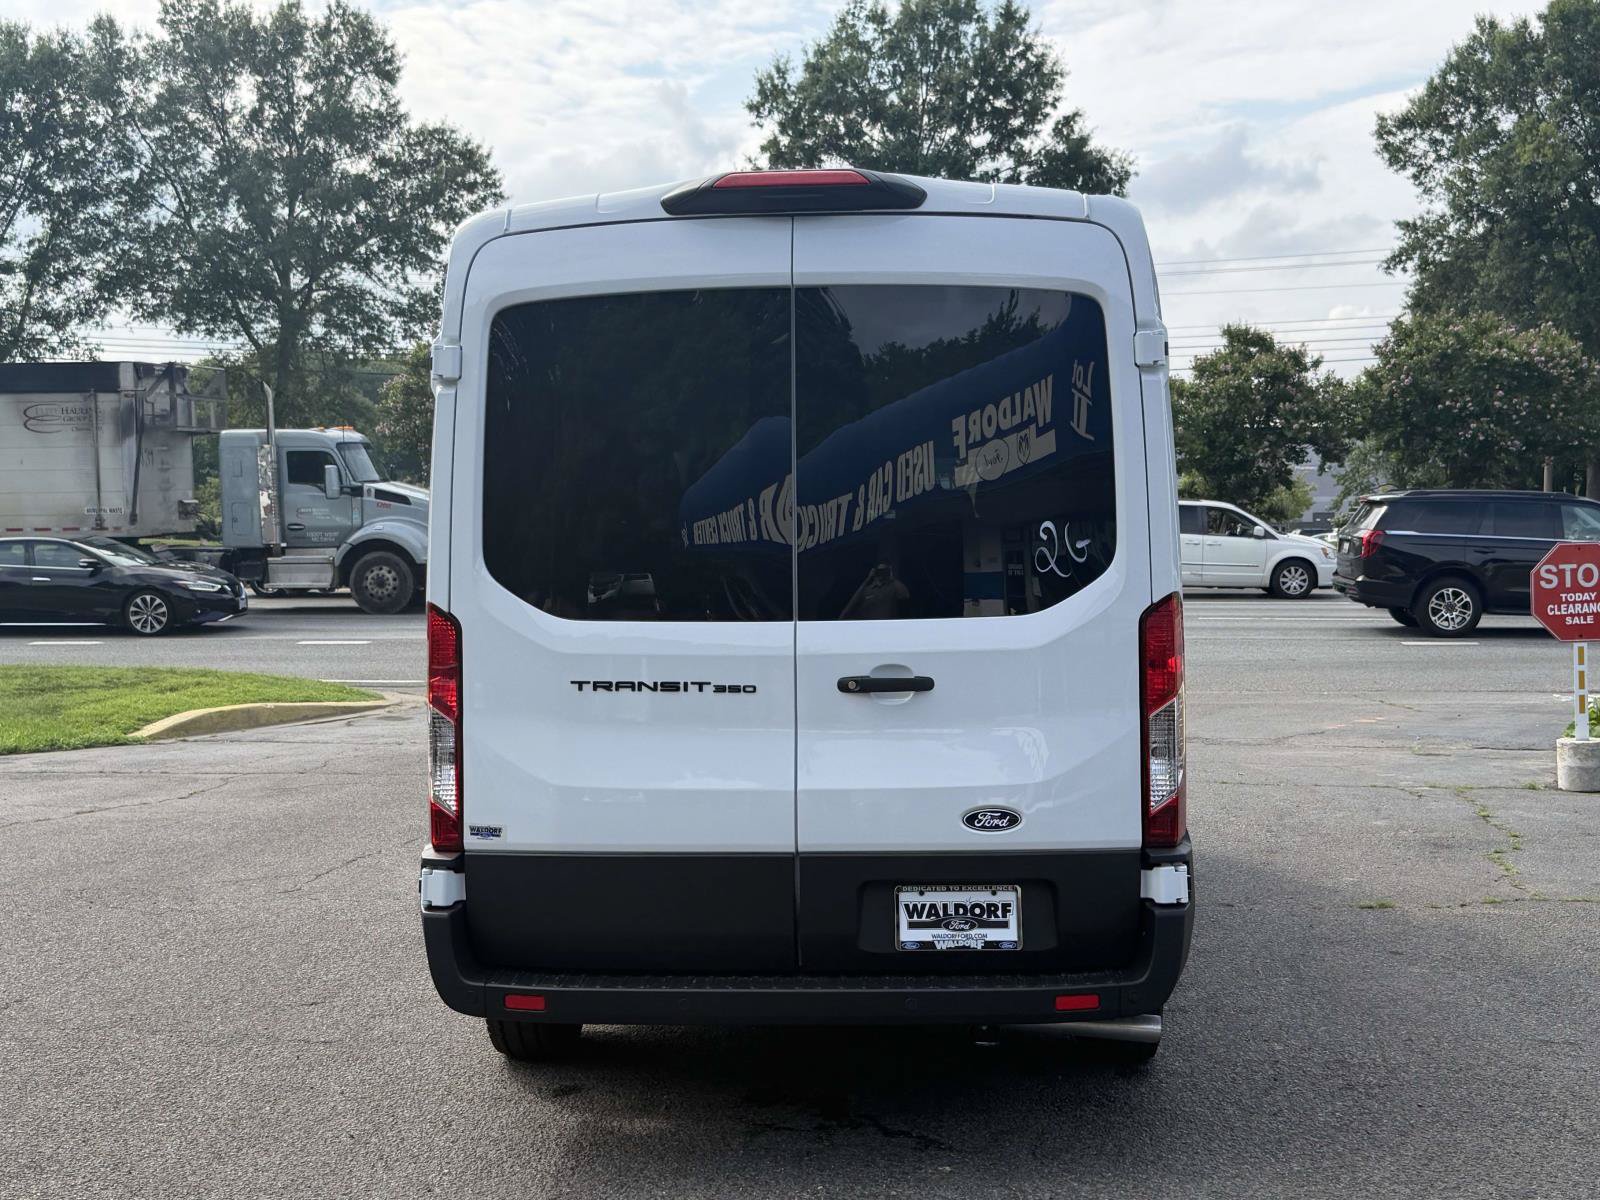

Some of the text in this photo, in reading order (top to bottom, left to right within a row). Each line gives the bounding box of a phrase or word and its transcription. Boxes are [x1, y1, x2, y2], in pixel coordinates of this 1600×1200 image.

[1560, 592, 1597, 602] TODAY
[1565, 615, 1594, 625] SALE
[570, 681, 757, 694] TRANSIT 350
[974, 811, 1010, 827] Ford
[469, 825, 503, 835] WALDORF
[961, 884, 1015, 892] EXCELLENCE
[902, 901, 1013, 920] WALDORF
[948, 920, 971, 930] Ford
[933, 939, 985, 950] WALDORF
